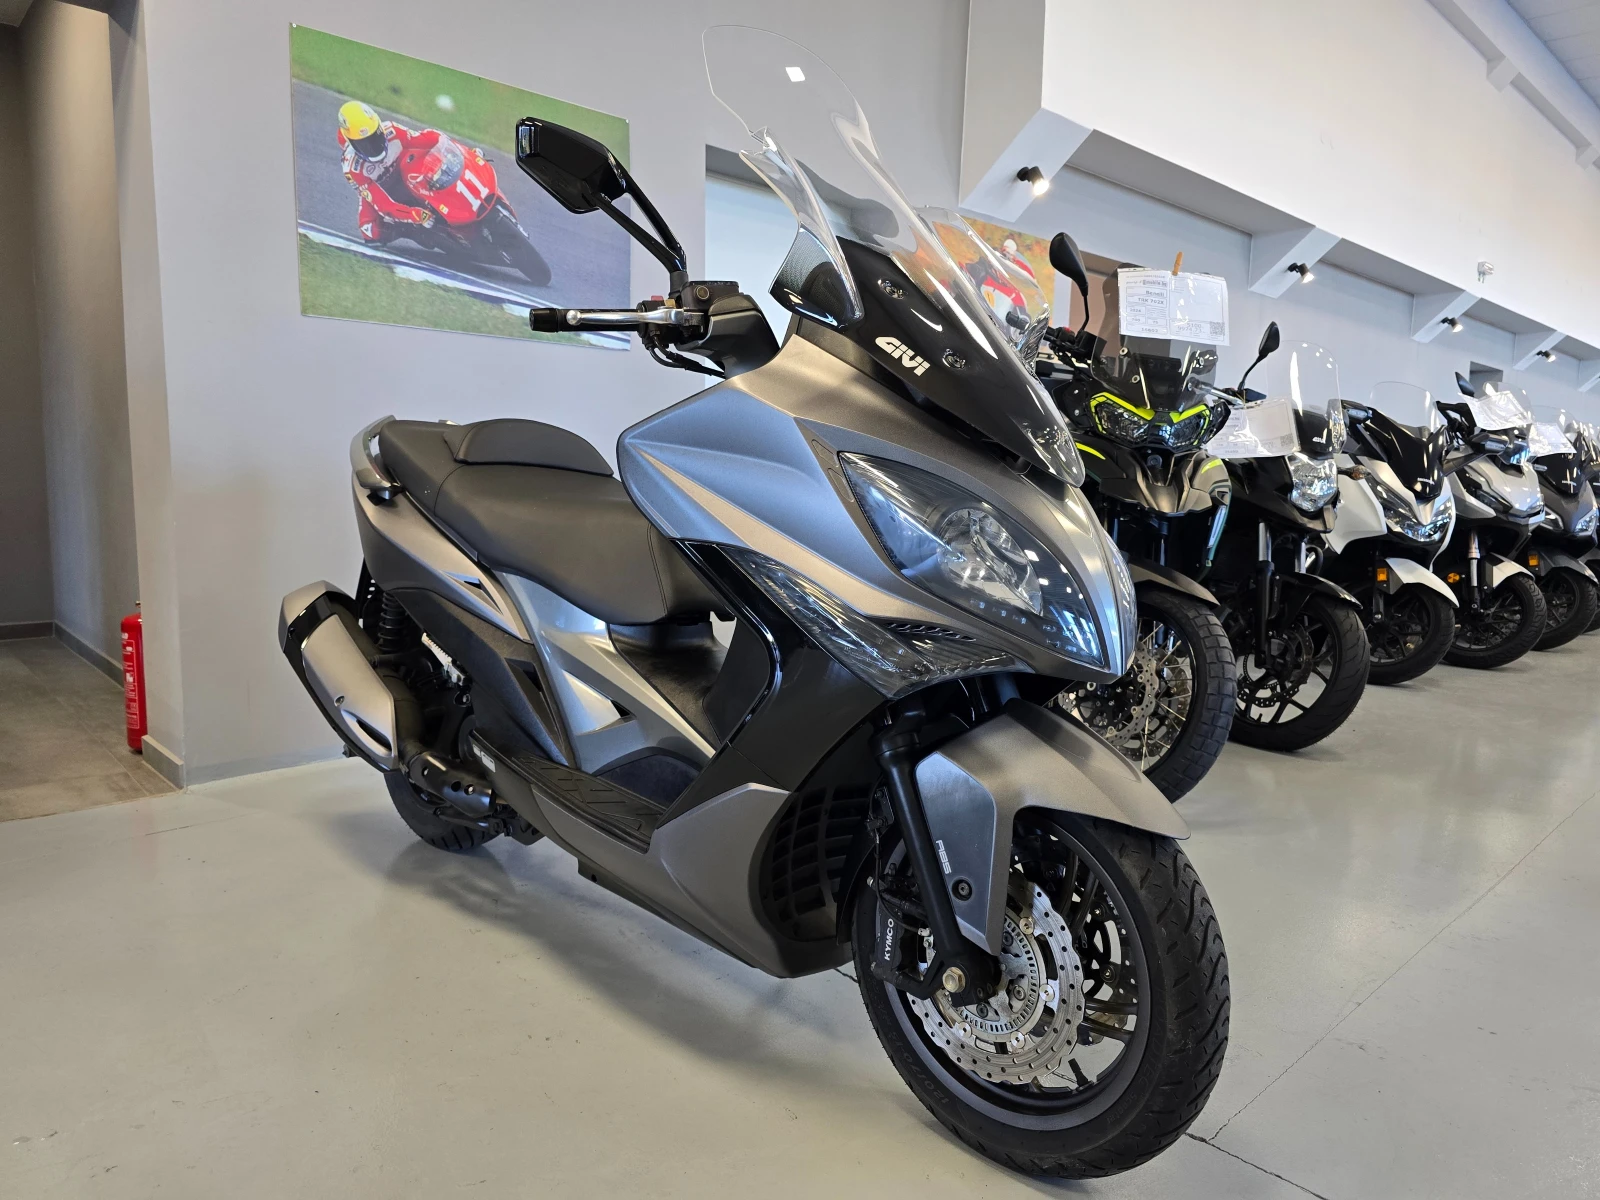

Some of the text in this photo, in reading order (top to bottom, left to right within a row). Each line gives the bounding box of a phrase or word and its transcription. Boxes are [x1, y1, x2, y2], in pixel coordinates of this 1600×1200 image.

[456, 169, 489, 212] 11
[875, 336, 931, 377] GIVI
[935, 839, 953, 875] ABS
[884, 918, 895, 961] KYMCO
